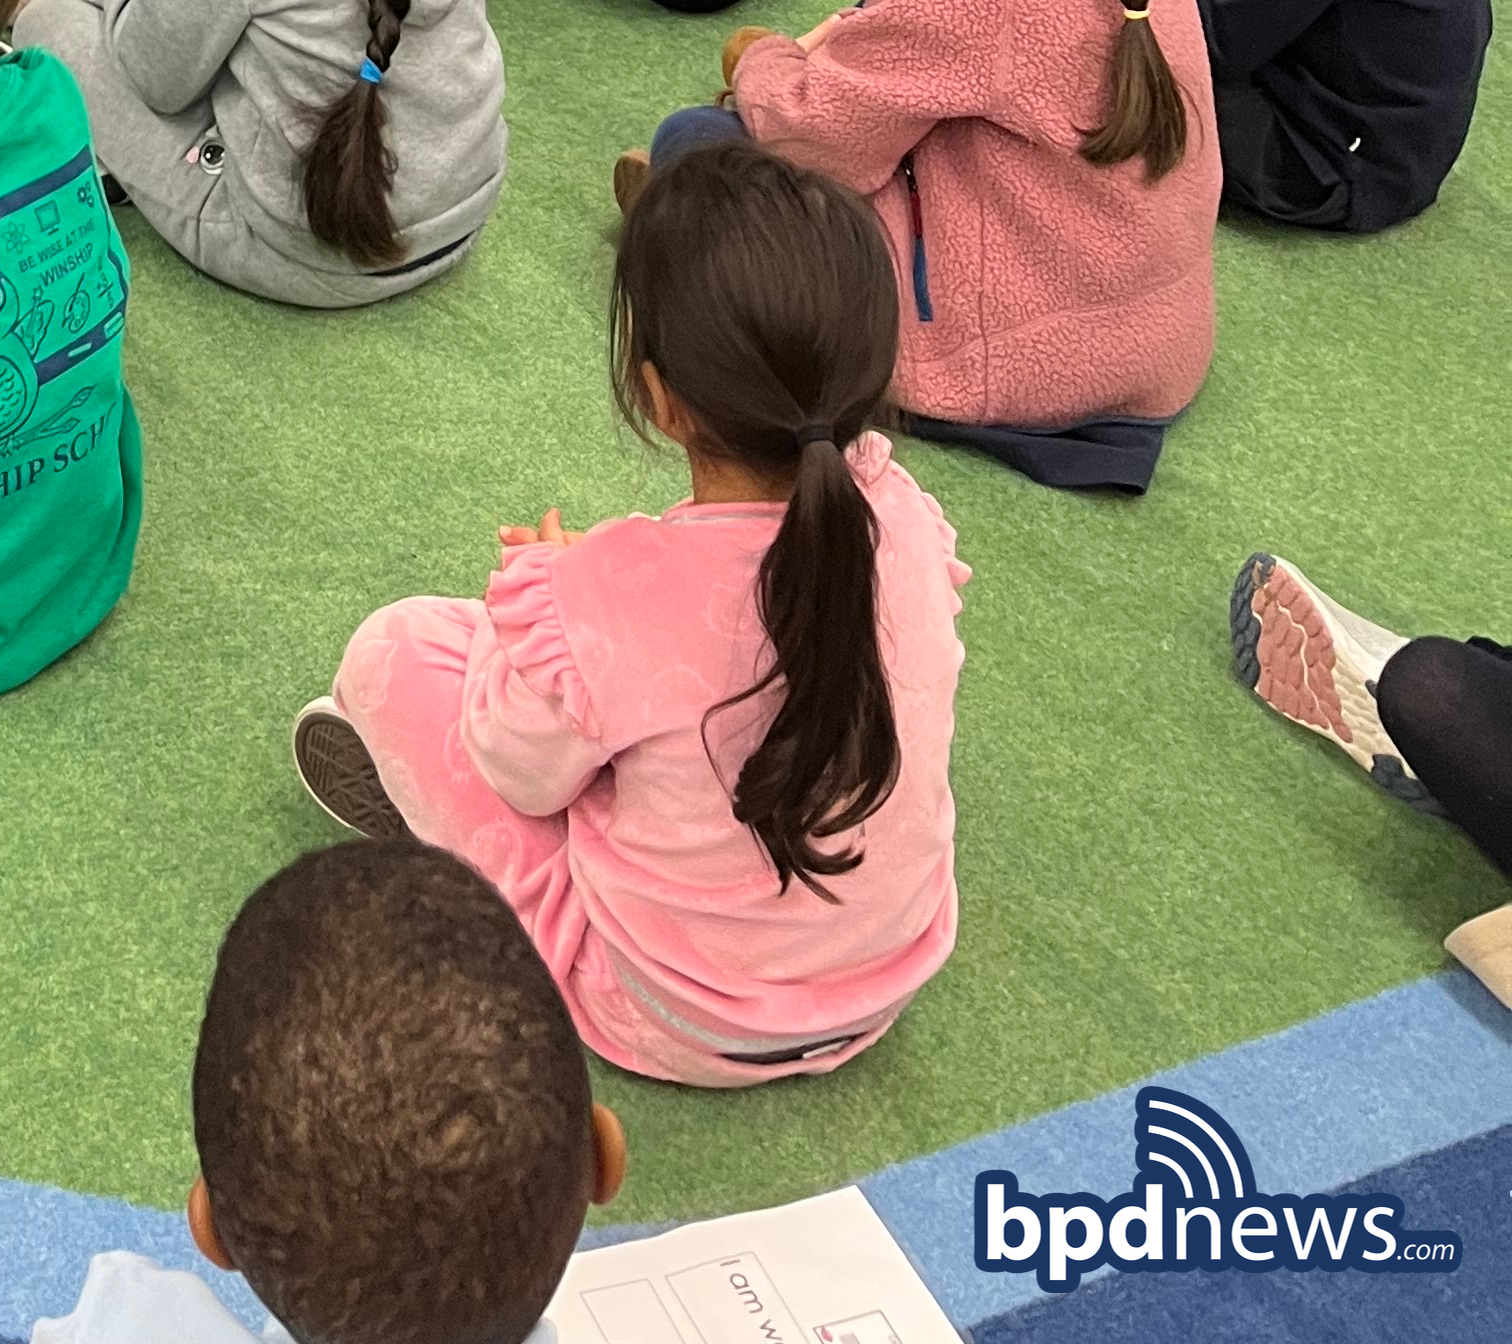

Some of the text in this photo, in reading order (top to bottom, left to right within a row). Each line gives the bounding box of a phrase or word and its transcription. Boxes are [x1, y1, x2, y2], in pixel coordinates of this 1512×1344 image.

[18, 219, 96, 274] BE WISE AT THE
[39, 242, 94, 287] WINSHIP
[719, 1259, 785, 1344] I am w
